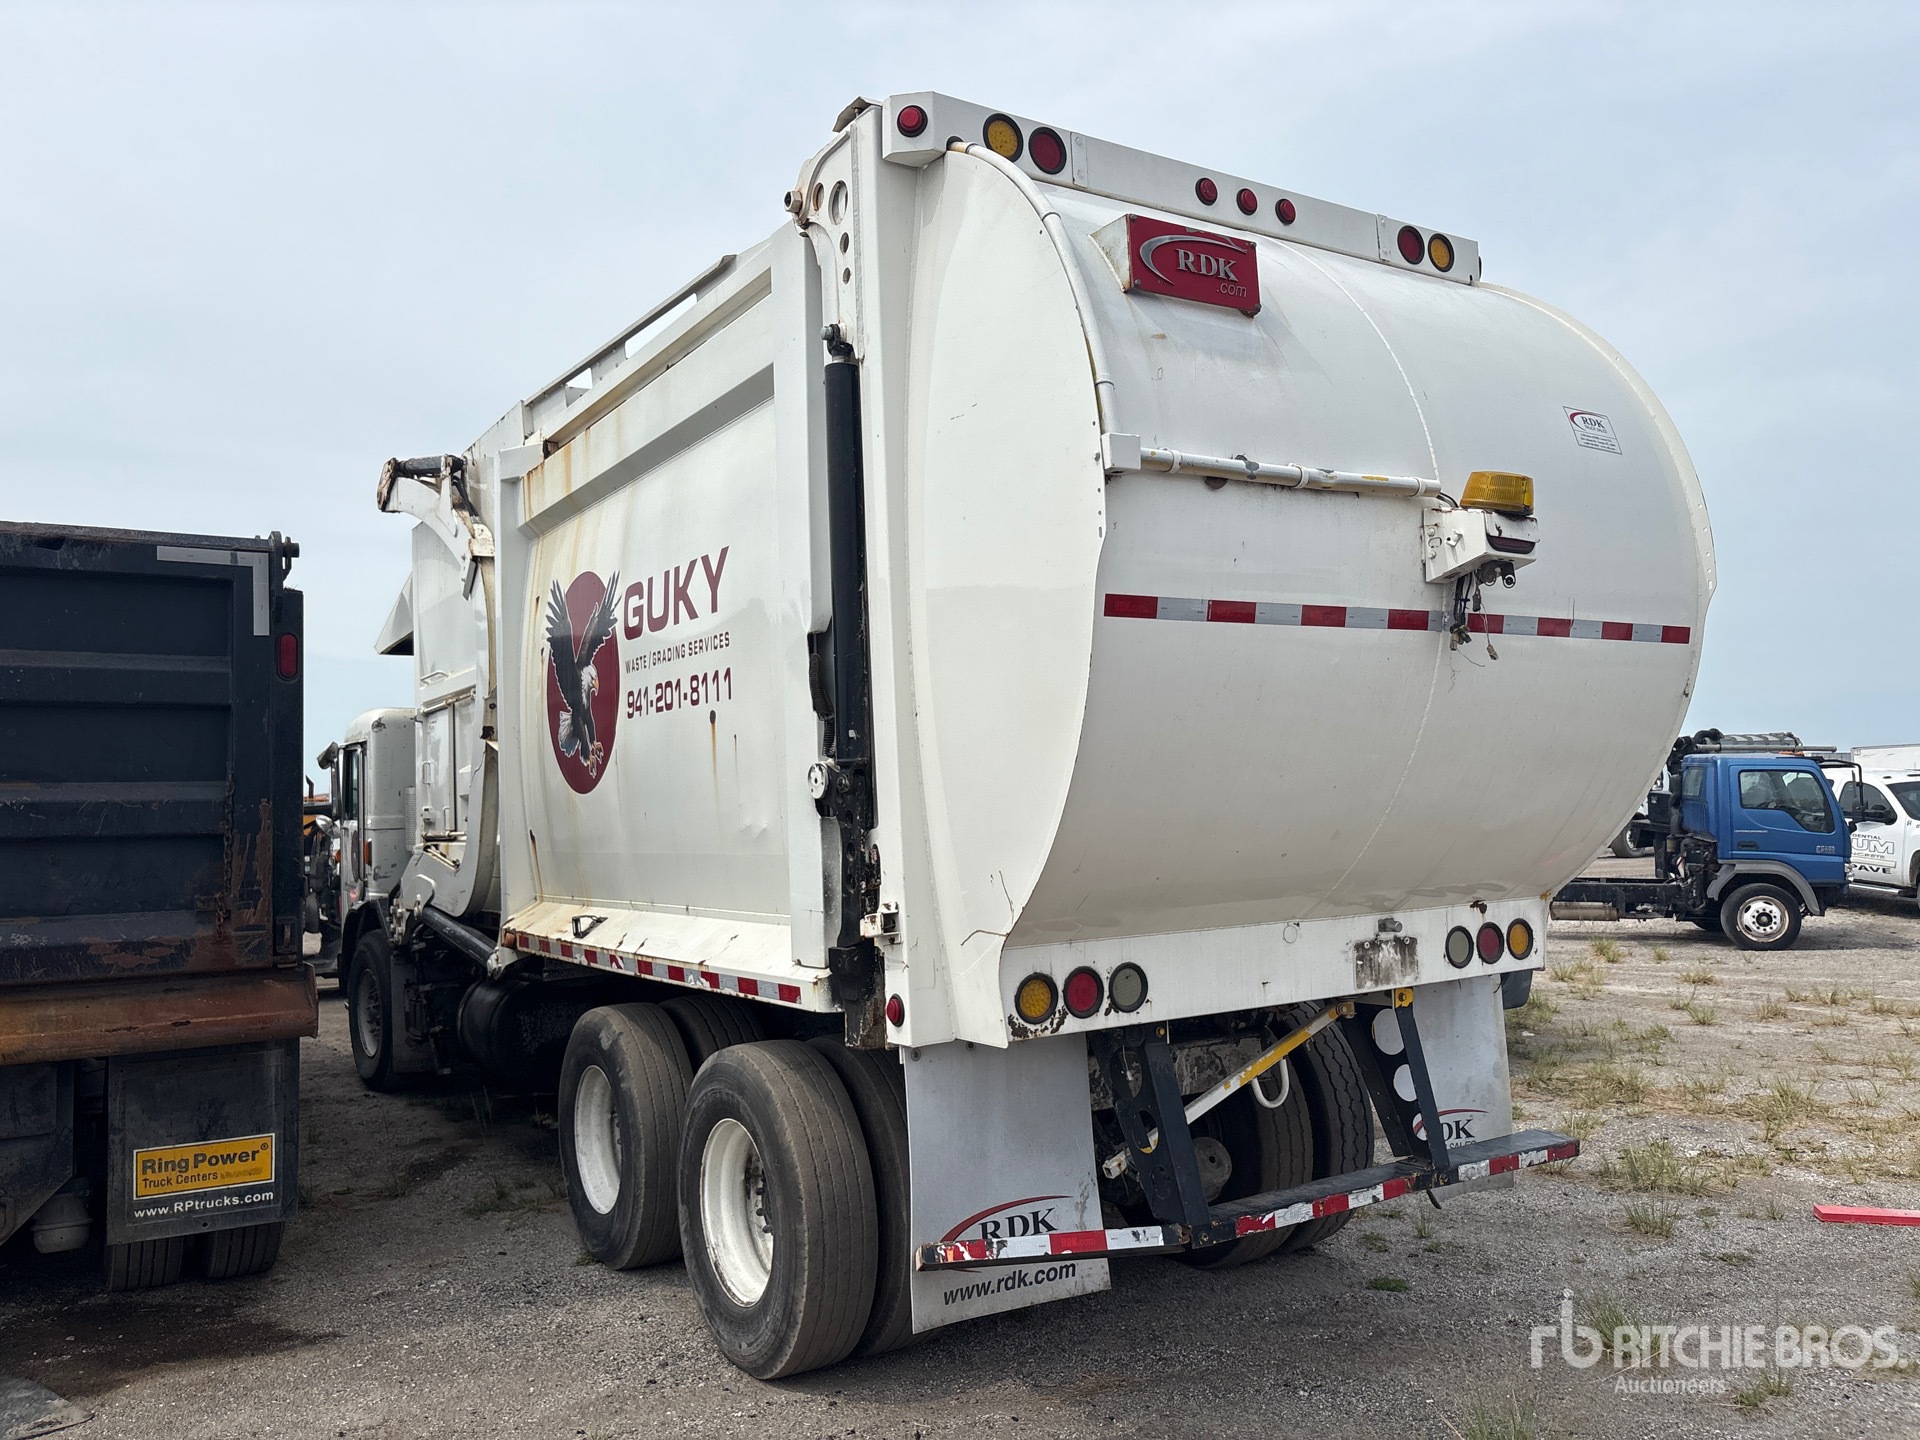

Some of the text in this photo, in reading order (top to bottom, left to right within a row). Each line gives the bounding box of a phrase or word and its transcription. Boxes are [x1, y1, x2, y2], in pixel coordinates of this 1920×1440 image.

[1176, 248, 1239, 282] RDK
[1216, 283, 1247, 298] .com
[1580, 416, 1606, 429] RDK
[624, 545, 730, 641] GUKY
[688, 631, 730, 657] SERVICES
[627, 667, 732, 719] 941-201-8111
[1440, 1118, 1475, 1141] DK
[142, 1149, 260, 1176] Ring Power
[142, 1176, 173, 1189] Truck
[176, 1171, 218, 1185] Centers
[134, 1191, 274, 1218] www.RPtrucks.com
[978, 1207, 1058, 1239] RDK
[943, 1262, 1076, 1306] www.rdk.com
